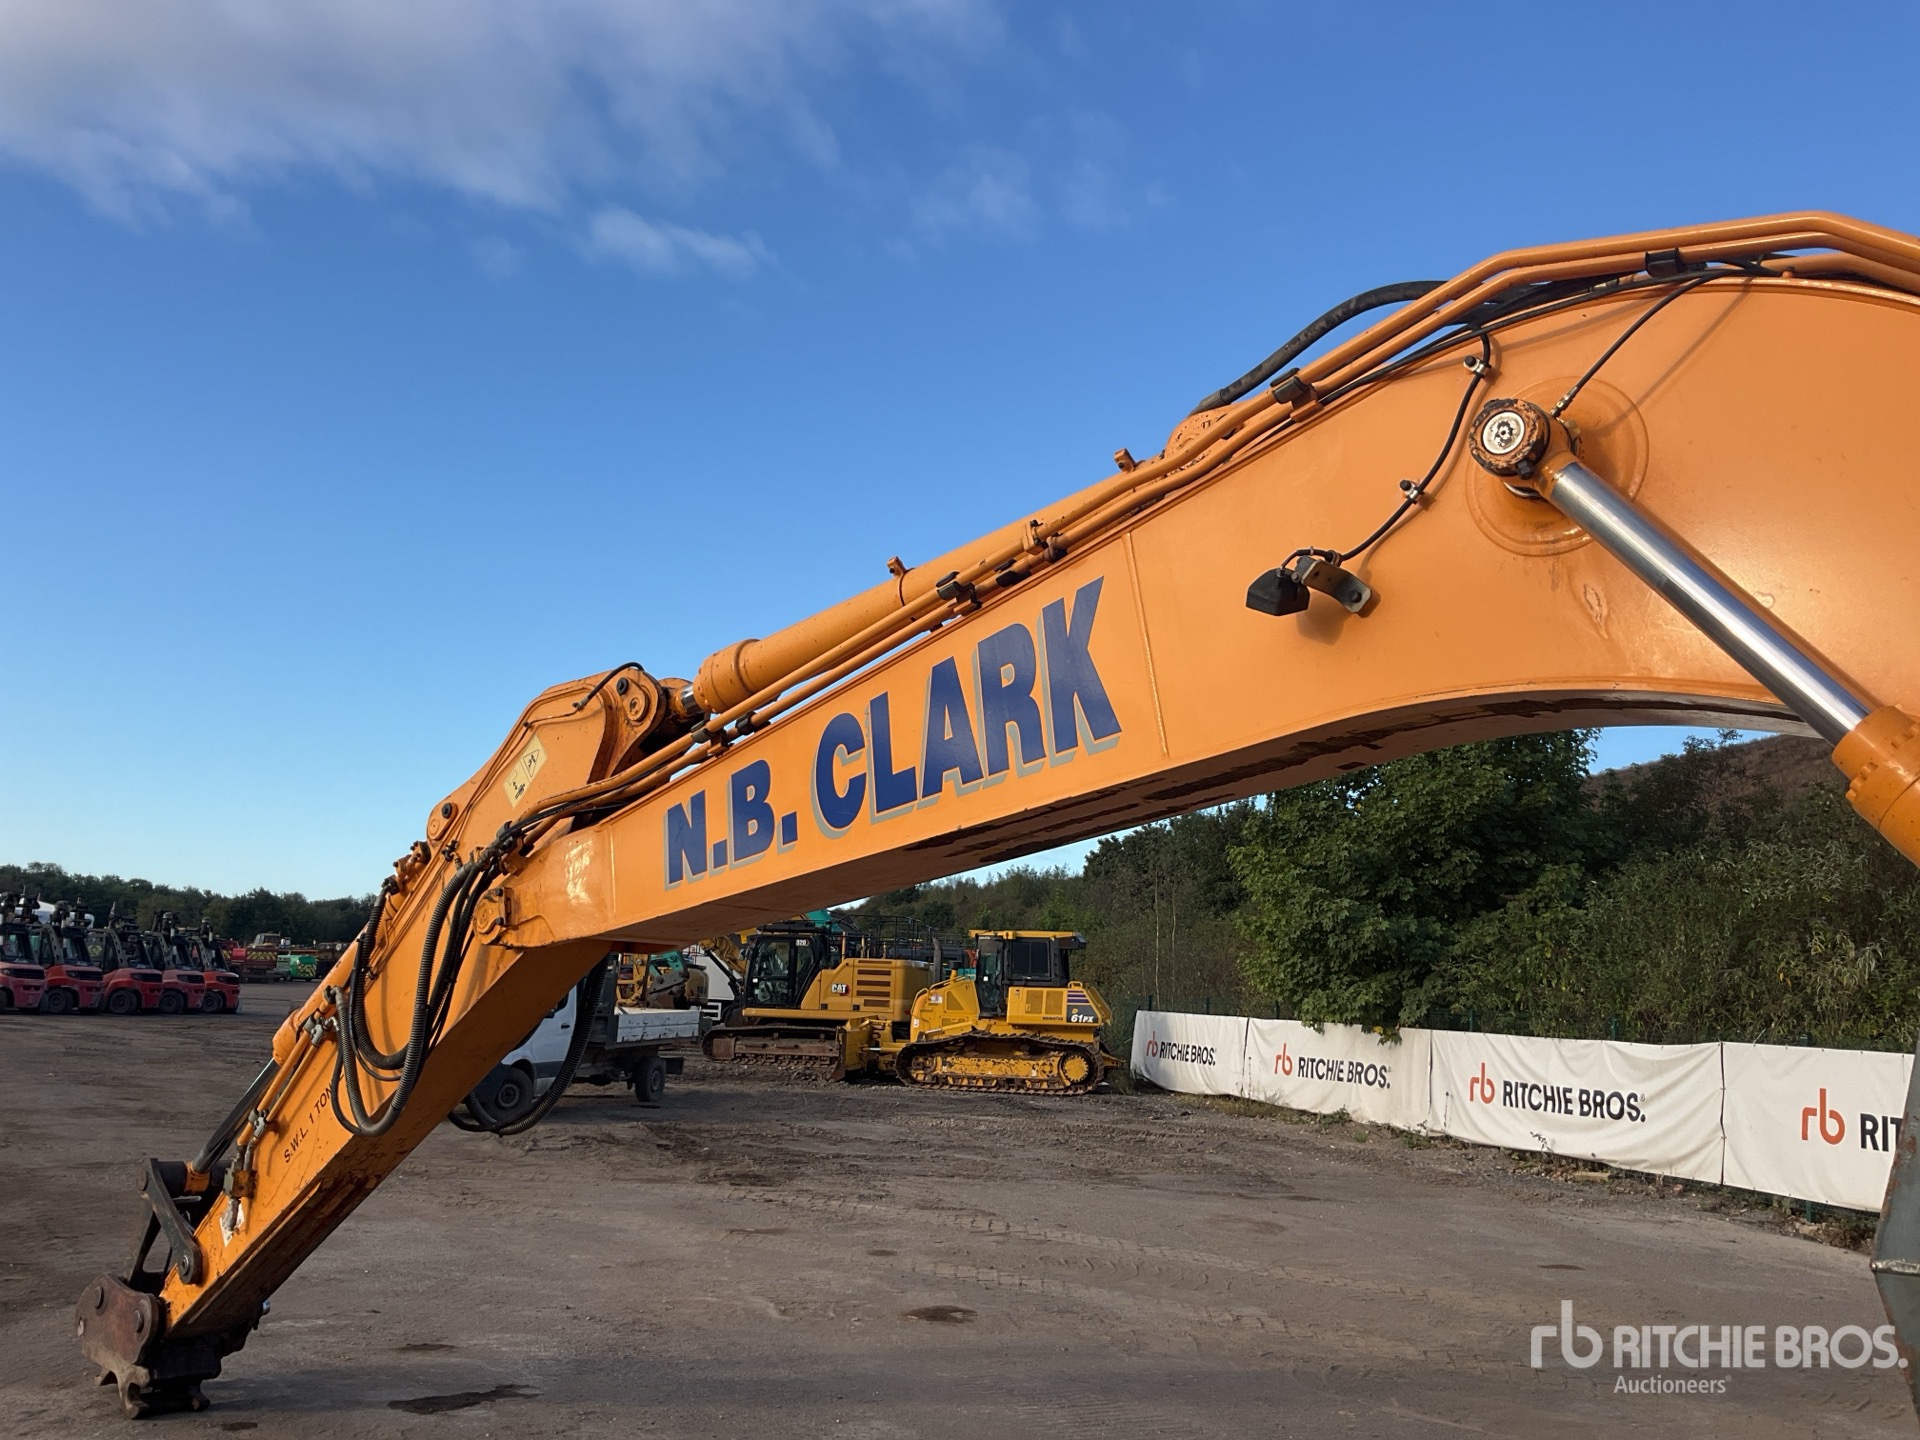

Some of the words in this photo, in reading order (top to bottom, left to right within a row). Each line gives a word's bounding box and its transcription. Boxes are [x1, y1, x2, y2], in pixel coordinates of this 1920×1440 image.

[664, 759, 798, 891] N.B.
[812, 575, 1122, 839] CLARK
[831, 984, 848, 994] CAT
[1070, 1014, 1094, 1023] 61PX
[1146, 1031, 1158, 1057] rb
[1160, 1042, 1189, 1062] RITCHIE
[1190, 1045, 1216, 1066] BROS.
[1274, 1043, 1293, 1075] rb
[1297, 1056, 1344, 1082] RITCHIE
[1346, 1060, 1391, 1089] BROS.
[1469, 1062, 1495, 1104] rb
[1503, 1079, 1573, 1115] RITCHIE
[1801, 1087, 1846, 1145] rb
